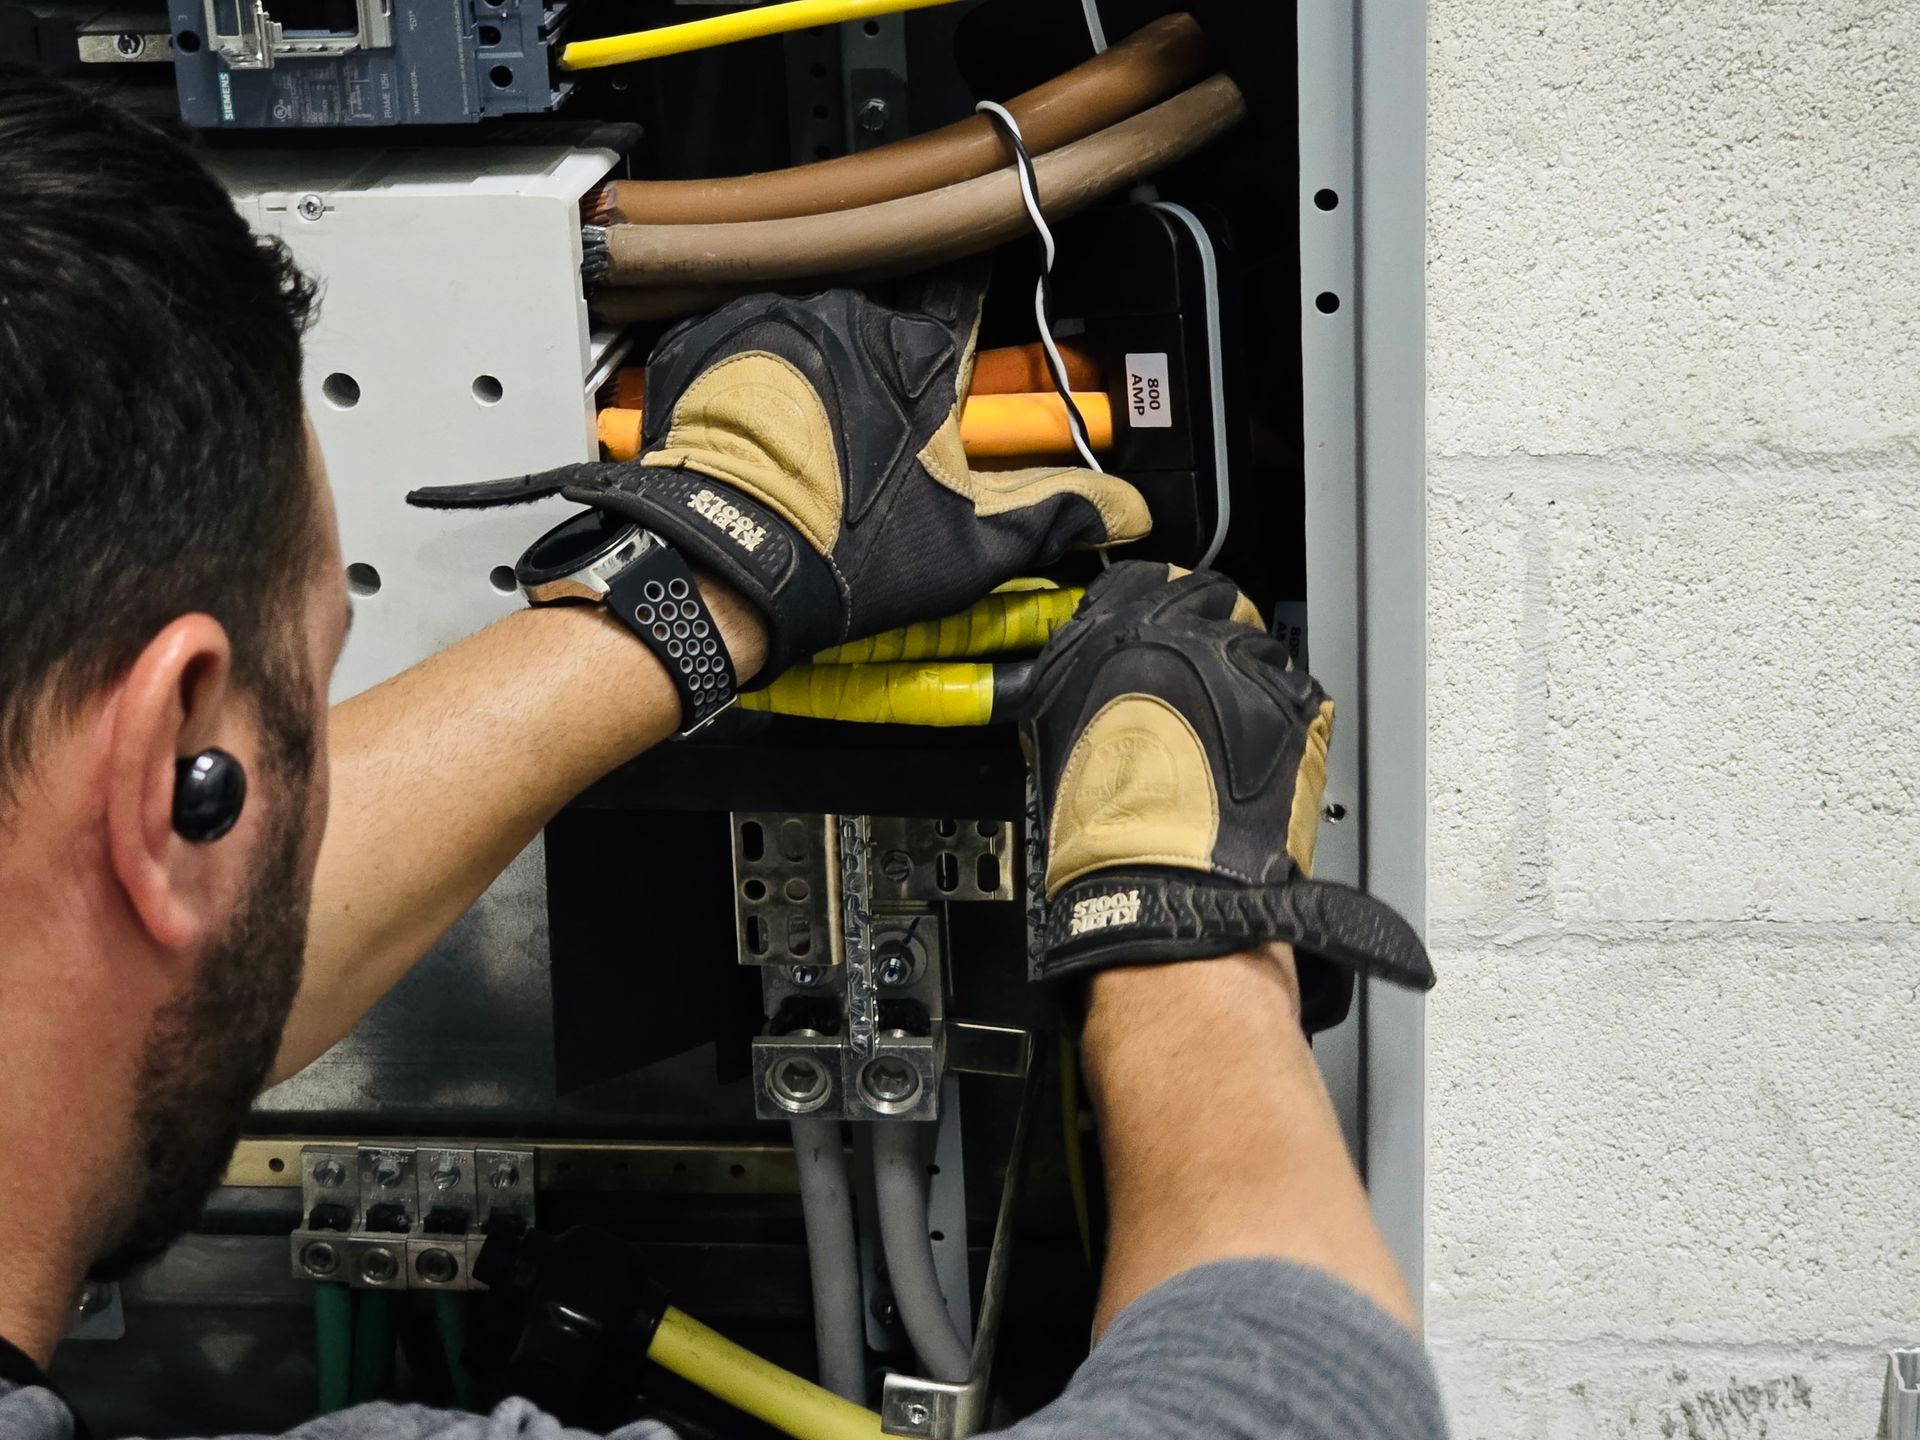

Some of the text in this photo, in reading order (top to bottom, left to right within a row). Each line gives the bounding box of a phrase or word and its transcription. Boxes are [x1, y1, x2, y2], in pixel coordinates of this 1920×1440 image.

[219, 72, 235, 121] SIEMENS
[1131, 373, 1145, 417] AMP
[1147, 378, 1161, 411] 800
[687, 494, 764, 552] KLEIN
[698, 489, 767, 541] TOOLS
[1070, 905, 1139, 937] KLEIN
[1073, 889, 1141, 918] TOOLS
